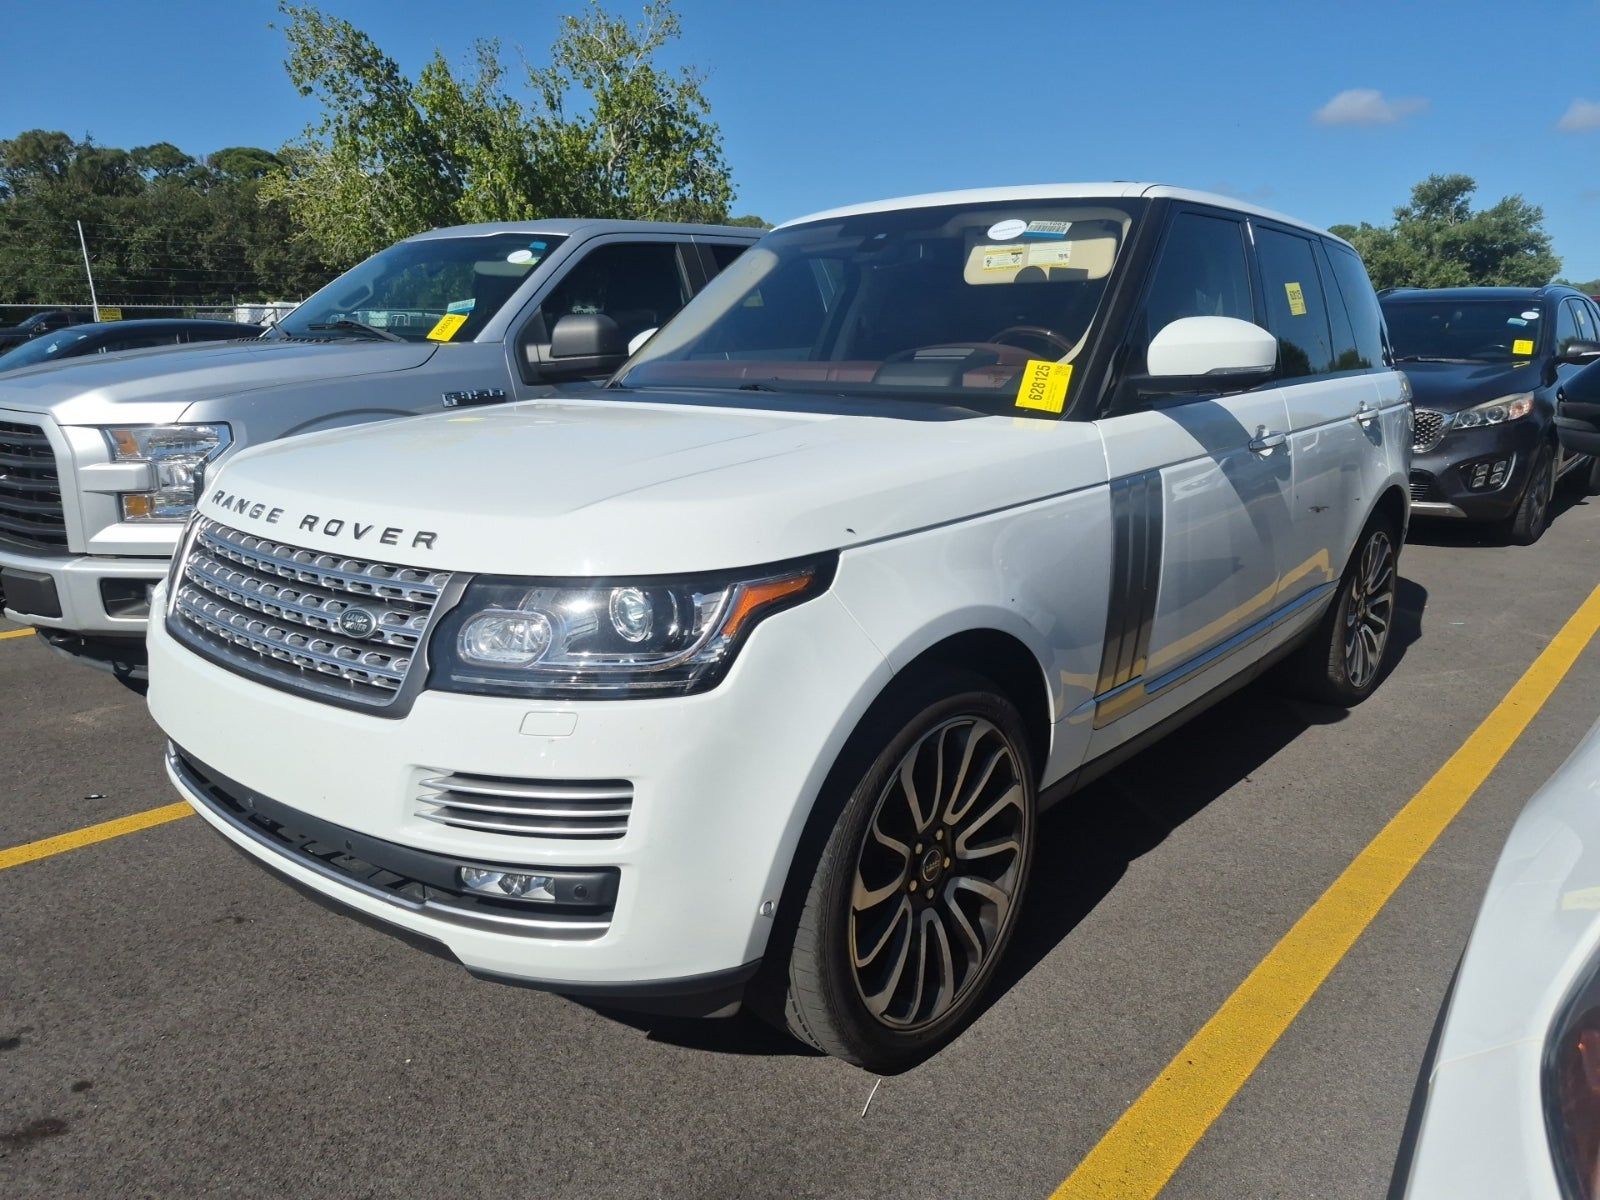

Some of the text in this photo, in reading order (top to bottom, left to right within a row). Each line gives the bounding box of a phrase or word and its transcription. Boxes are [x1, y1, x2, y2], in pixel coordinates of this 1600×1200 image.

[1028, 364, 1051, 401] 628125
[211, 490, 438, 551] RANGE ROVER
